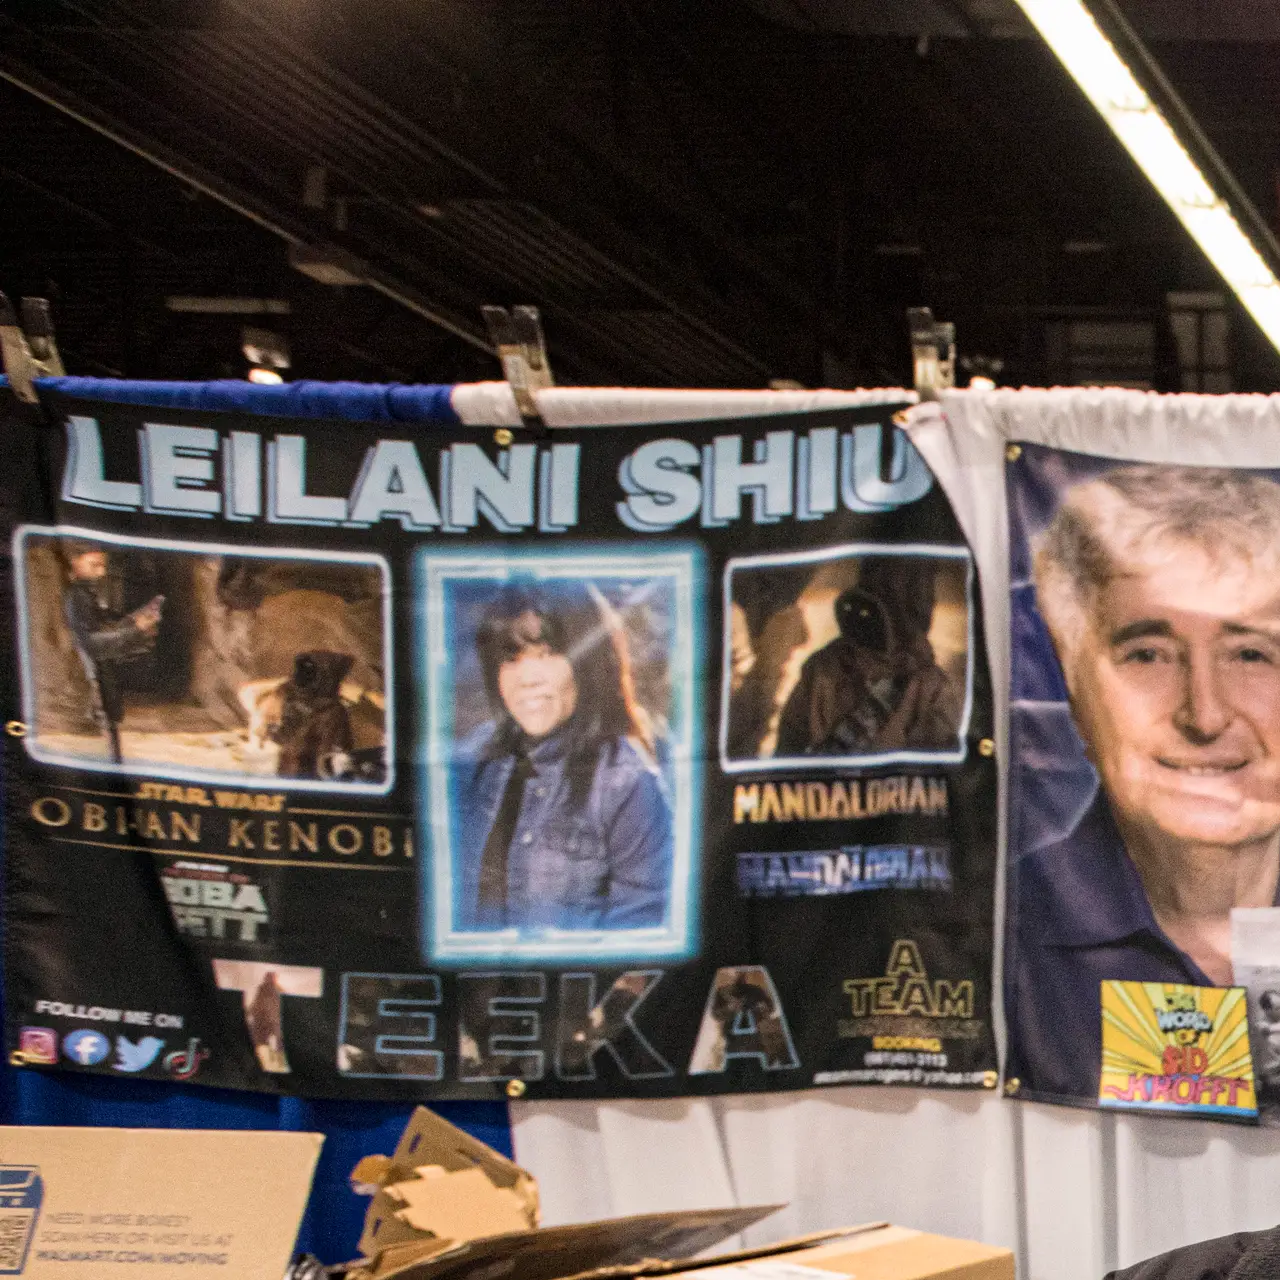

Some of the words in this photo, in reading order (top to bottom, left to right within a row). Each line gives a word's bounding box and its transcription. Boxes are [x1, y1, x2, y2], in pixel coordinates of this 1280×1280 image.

[62, 416, 582, 532] LEILANI
[617, 421, 934, 531] SHIU
[136, 782, 212, 807] STAR
[213, 790, 287, 813] WARS
[734, 776, 949, 825] MANDALORIAN
[31, 797, 201, 844] OBI-AN
[228, 818, 415, 859] KENOBI
[886, 938, 927, 978] A
[35, 1000, 123, 1022] FOLLOW
[123, 1010, 153, 1026] ME
[153, 1013, 185, 1029] ON
[842, 976, 976, 1019] TEAM
[1162, 1045, 1209, 1076] SID
